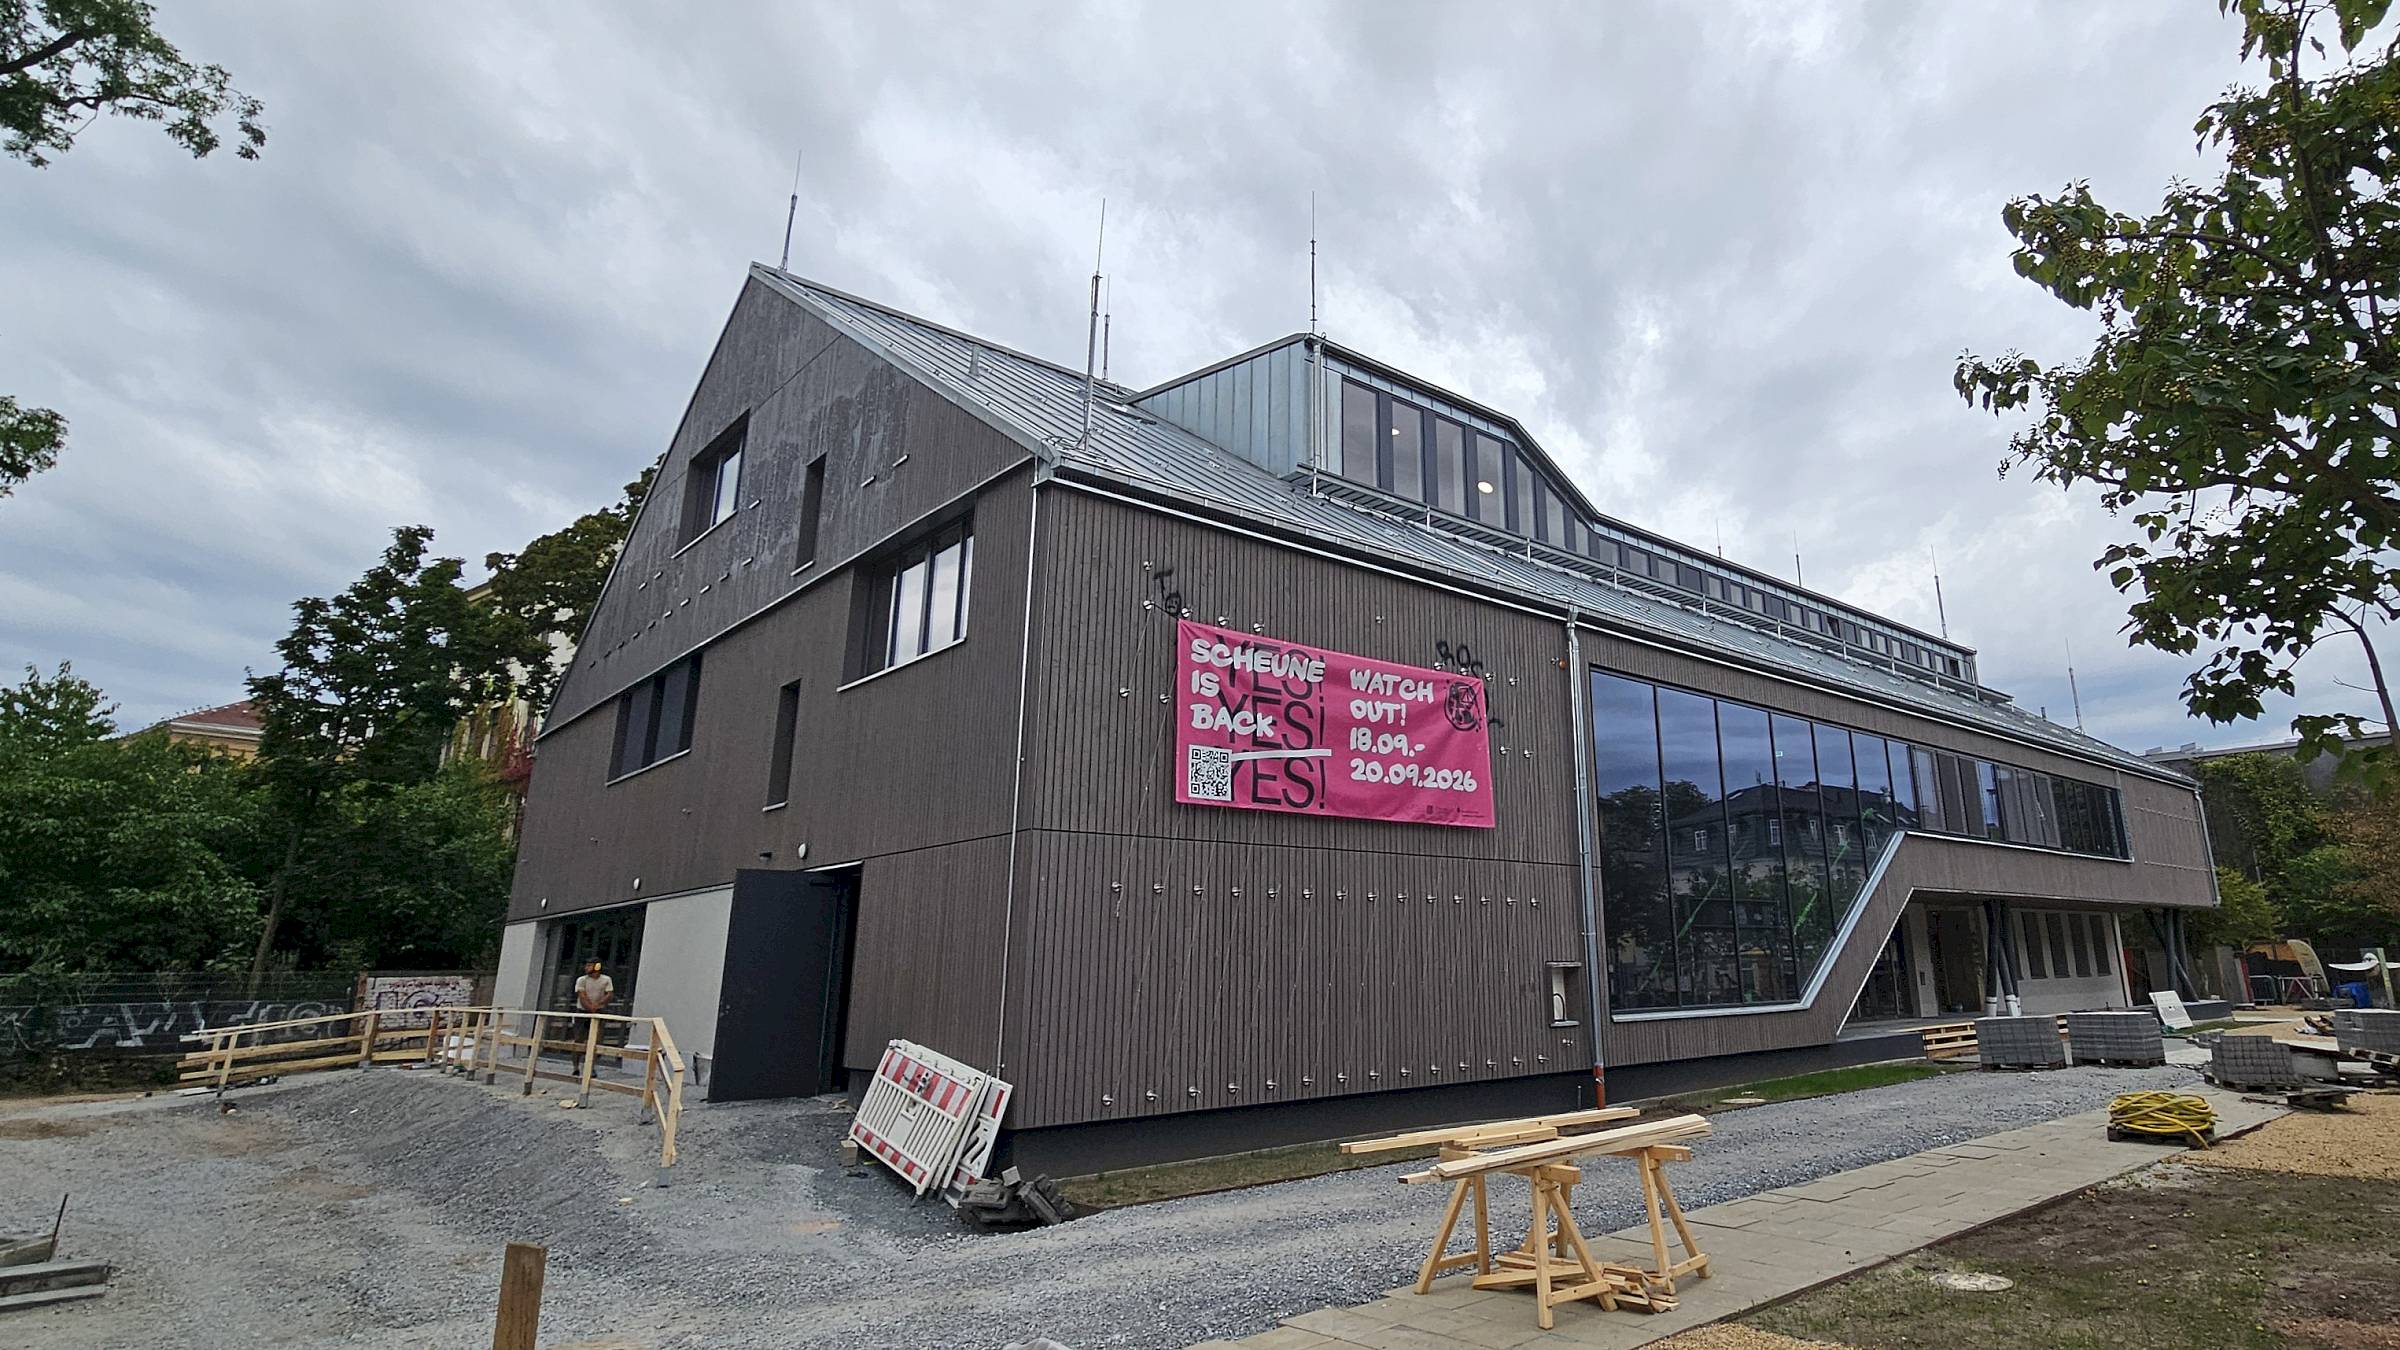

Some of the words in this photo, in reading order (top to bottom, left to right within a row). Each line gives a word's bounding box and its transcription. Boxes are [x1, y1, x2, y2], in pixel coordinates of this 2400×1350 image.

[1190, 638, 1326, 683] SCHEUNE
[1190, 669, 1220, 698] IS
[1349, 668, 1434, 704] WATCH
[1189, 703, 1274, 738] BACK
[1349, 698, 1407, 726] OUT!
[1349, 727, 1426, 757] 18.09.-
[1349, 757, 1478, 793] 20.09.2026
